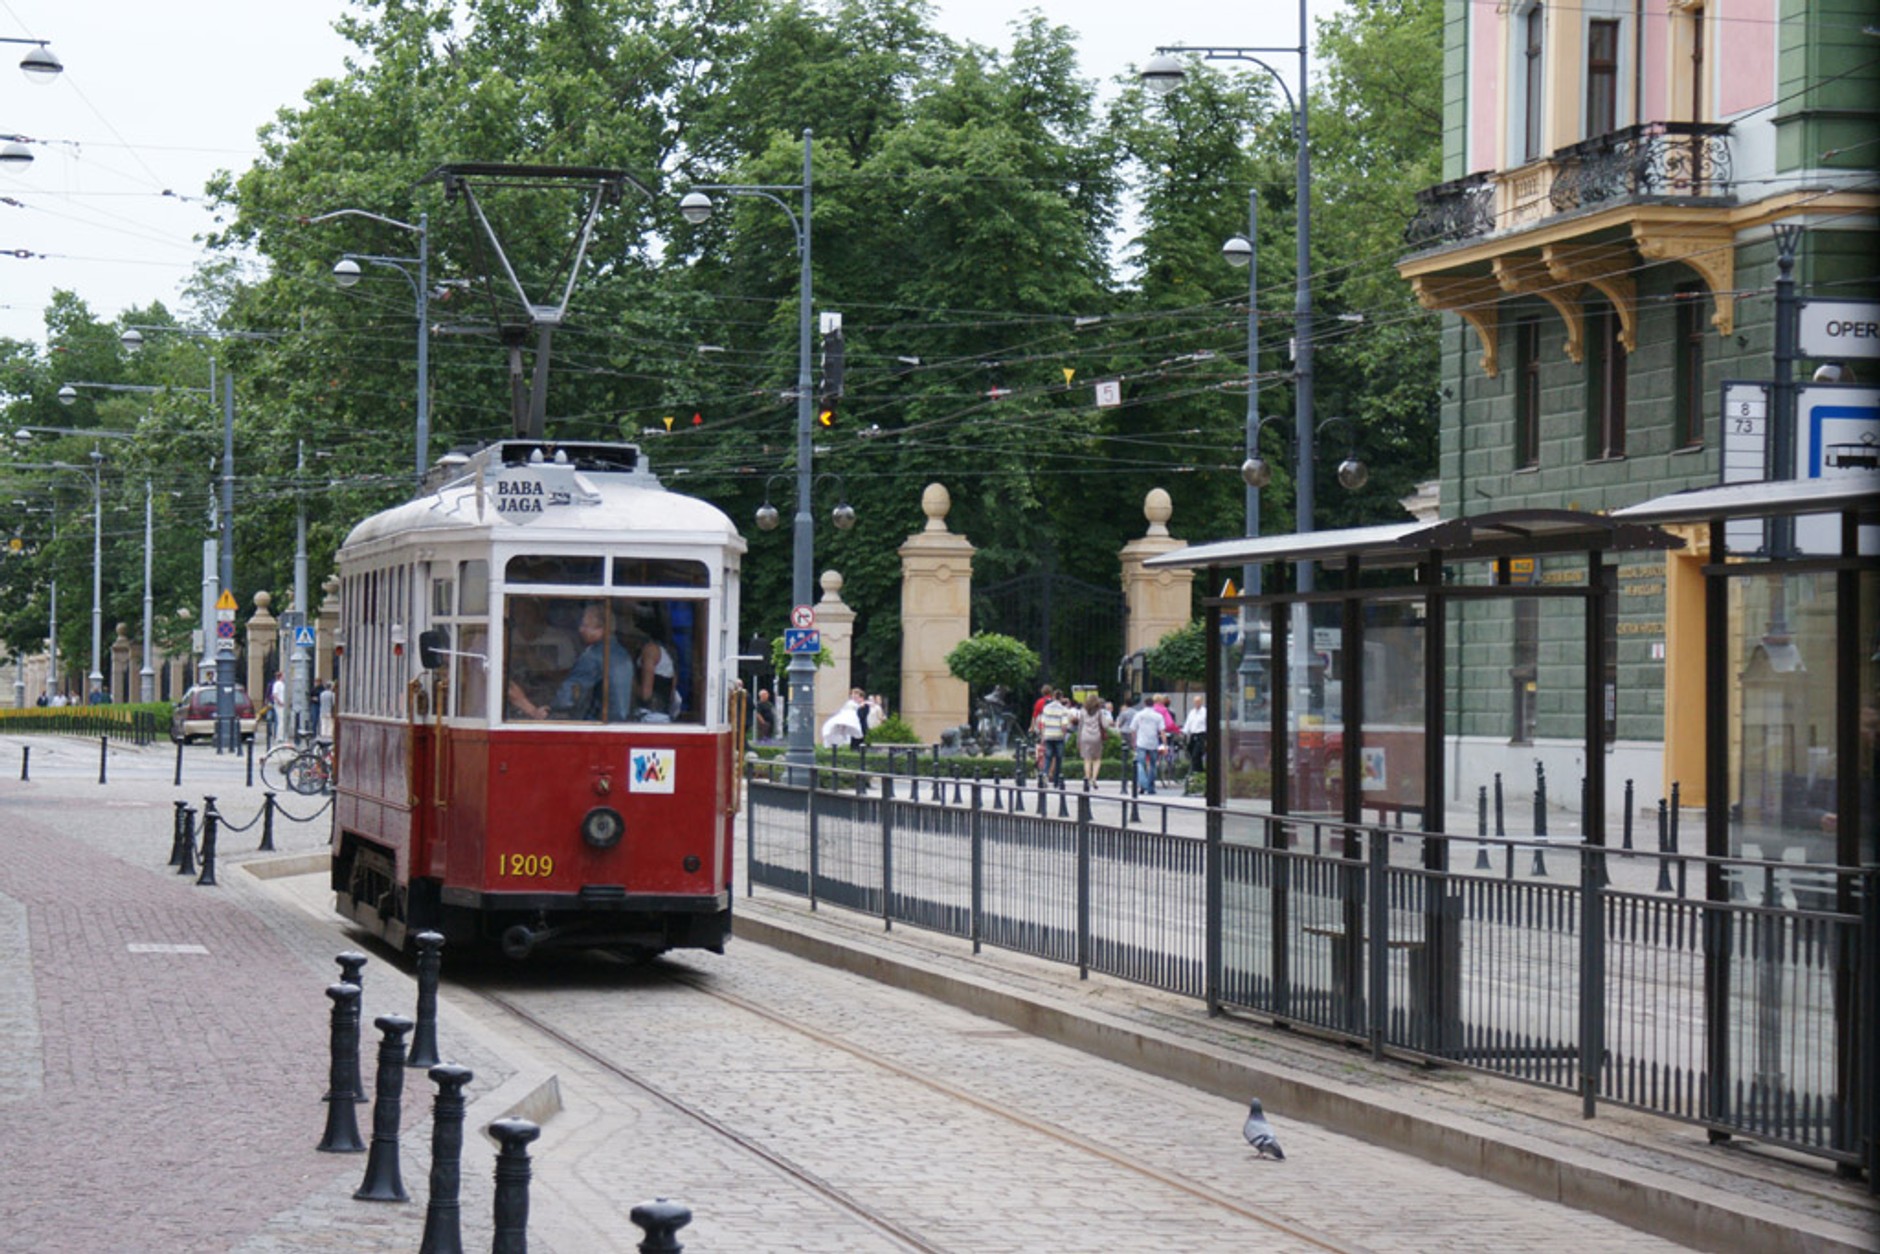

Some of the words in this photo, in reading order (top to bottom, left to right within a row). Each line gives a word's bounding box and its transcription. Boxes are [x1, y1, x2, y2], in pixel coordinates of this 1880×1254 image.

[1103, 385, 1114, 403] 5
[1741, 402, 1750, 416] 8
[1735, 418, 1753, 433] 73
[497, 481, 544, 495] BABA
[497, 498, 543, 512] JAGA
[499, 854, 553, 877] 1209
